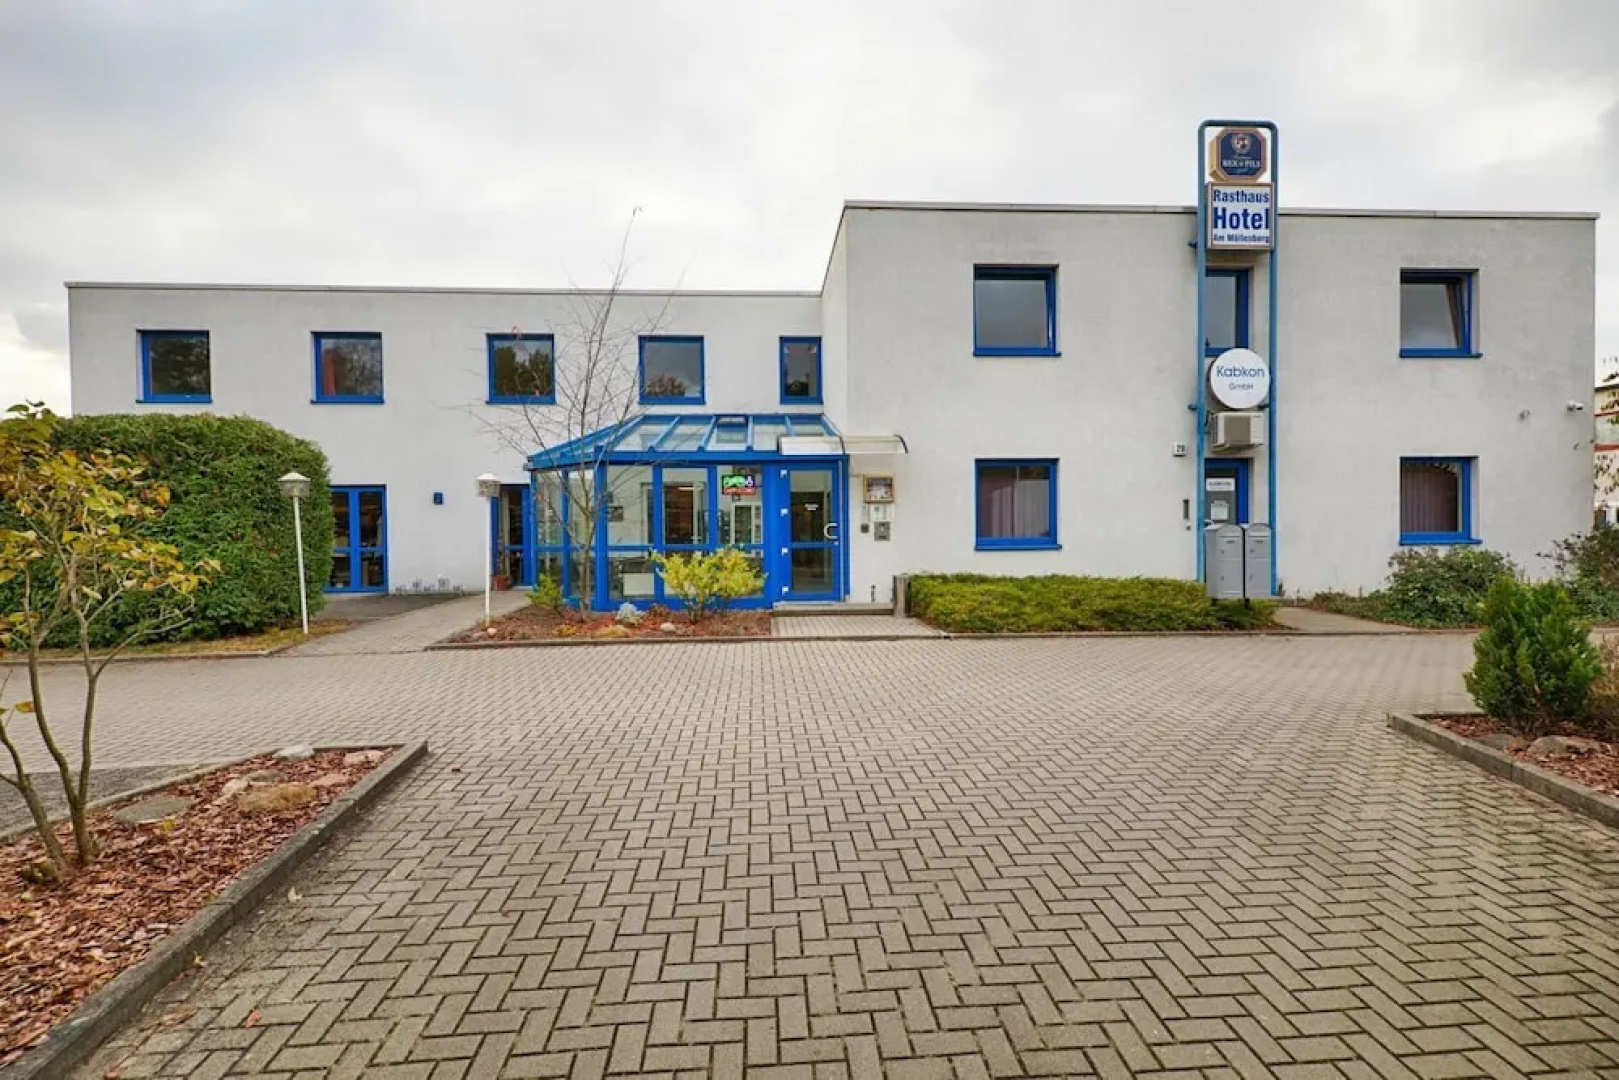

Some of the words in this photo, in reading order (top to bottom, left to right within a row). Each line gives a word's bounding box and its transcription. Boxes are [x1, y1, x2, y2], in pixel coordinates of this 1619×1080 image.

[1213, 189, 1269, 203] Rasthaus
[1213, 207, 1269, 229] Hotel
[1216, 365, 1265, 378] Kabkon
[1228, 382, 1254, 391] GmbH
